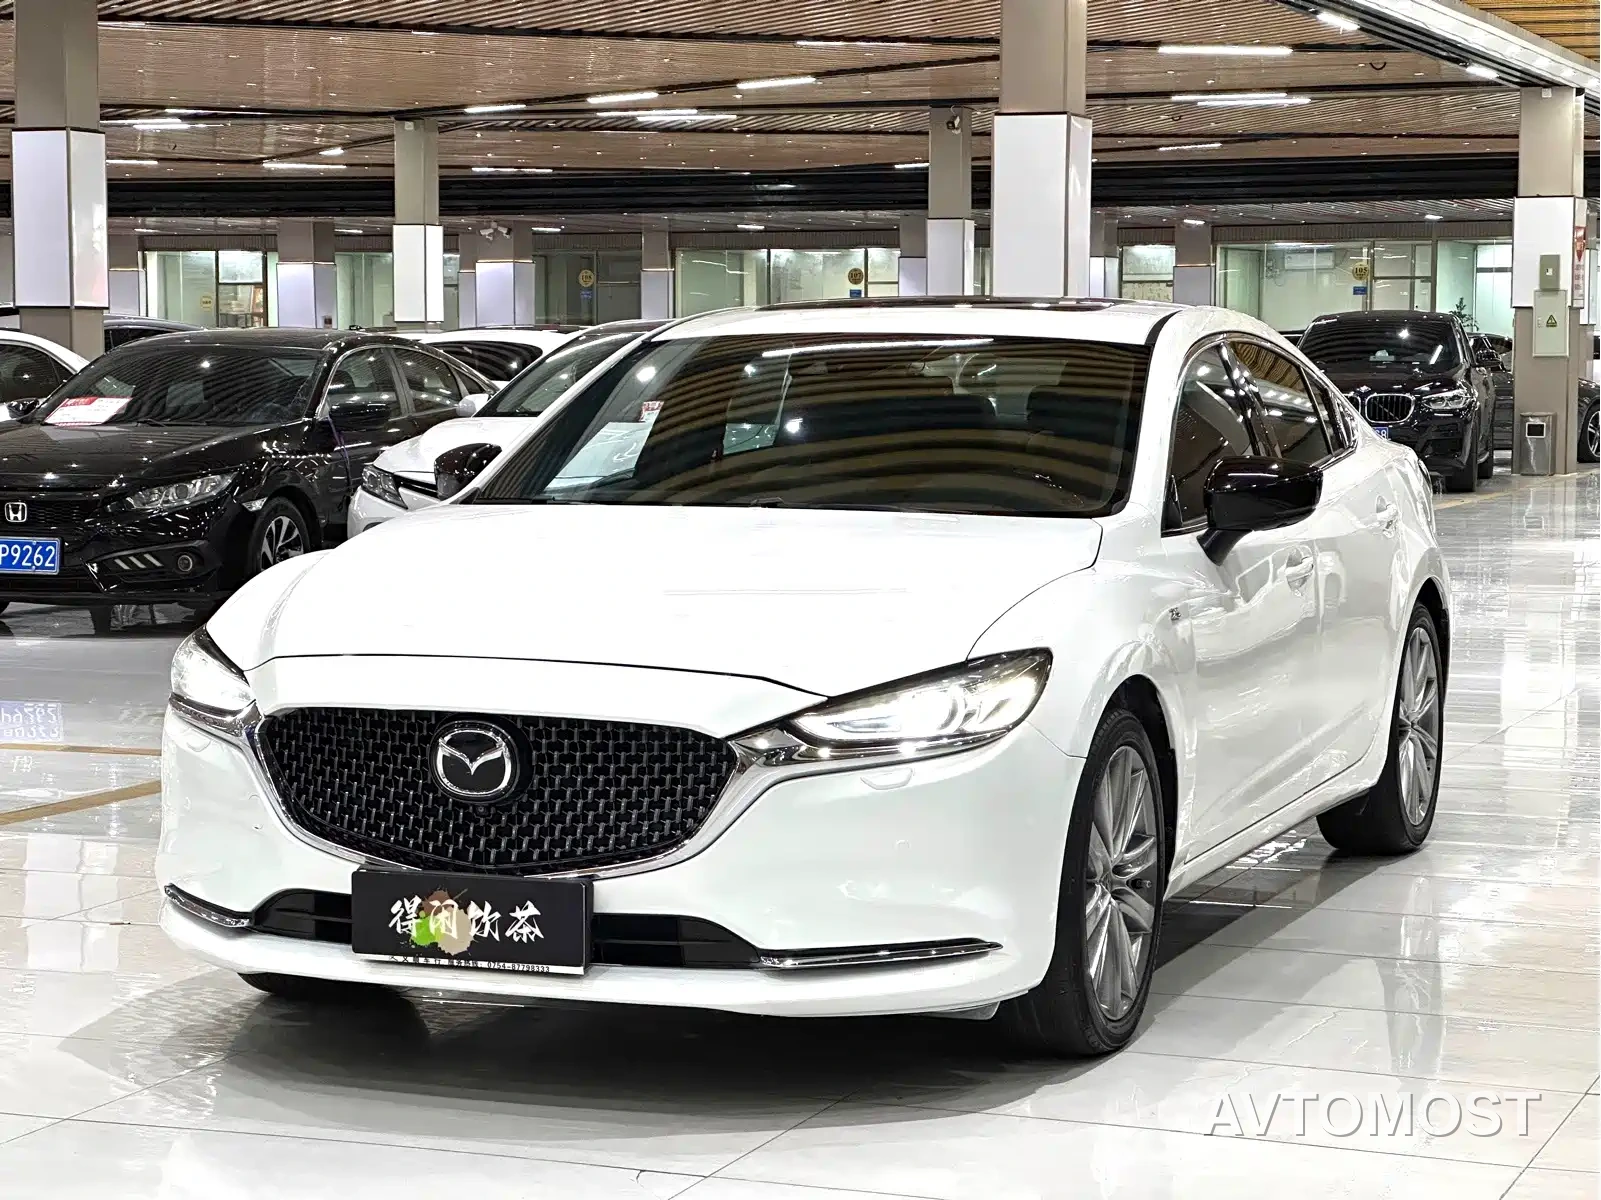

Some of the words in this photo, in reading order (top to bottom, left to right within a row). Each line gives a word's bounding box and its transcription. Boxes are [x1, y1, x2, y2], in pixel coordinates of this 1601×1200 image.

[1355, 266, 1368, 274] 105
[0, 544, 55, 567] P9262
[388, 895, 544, 943] 得闲饮茶
